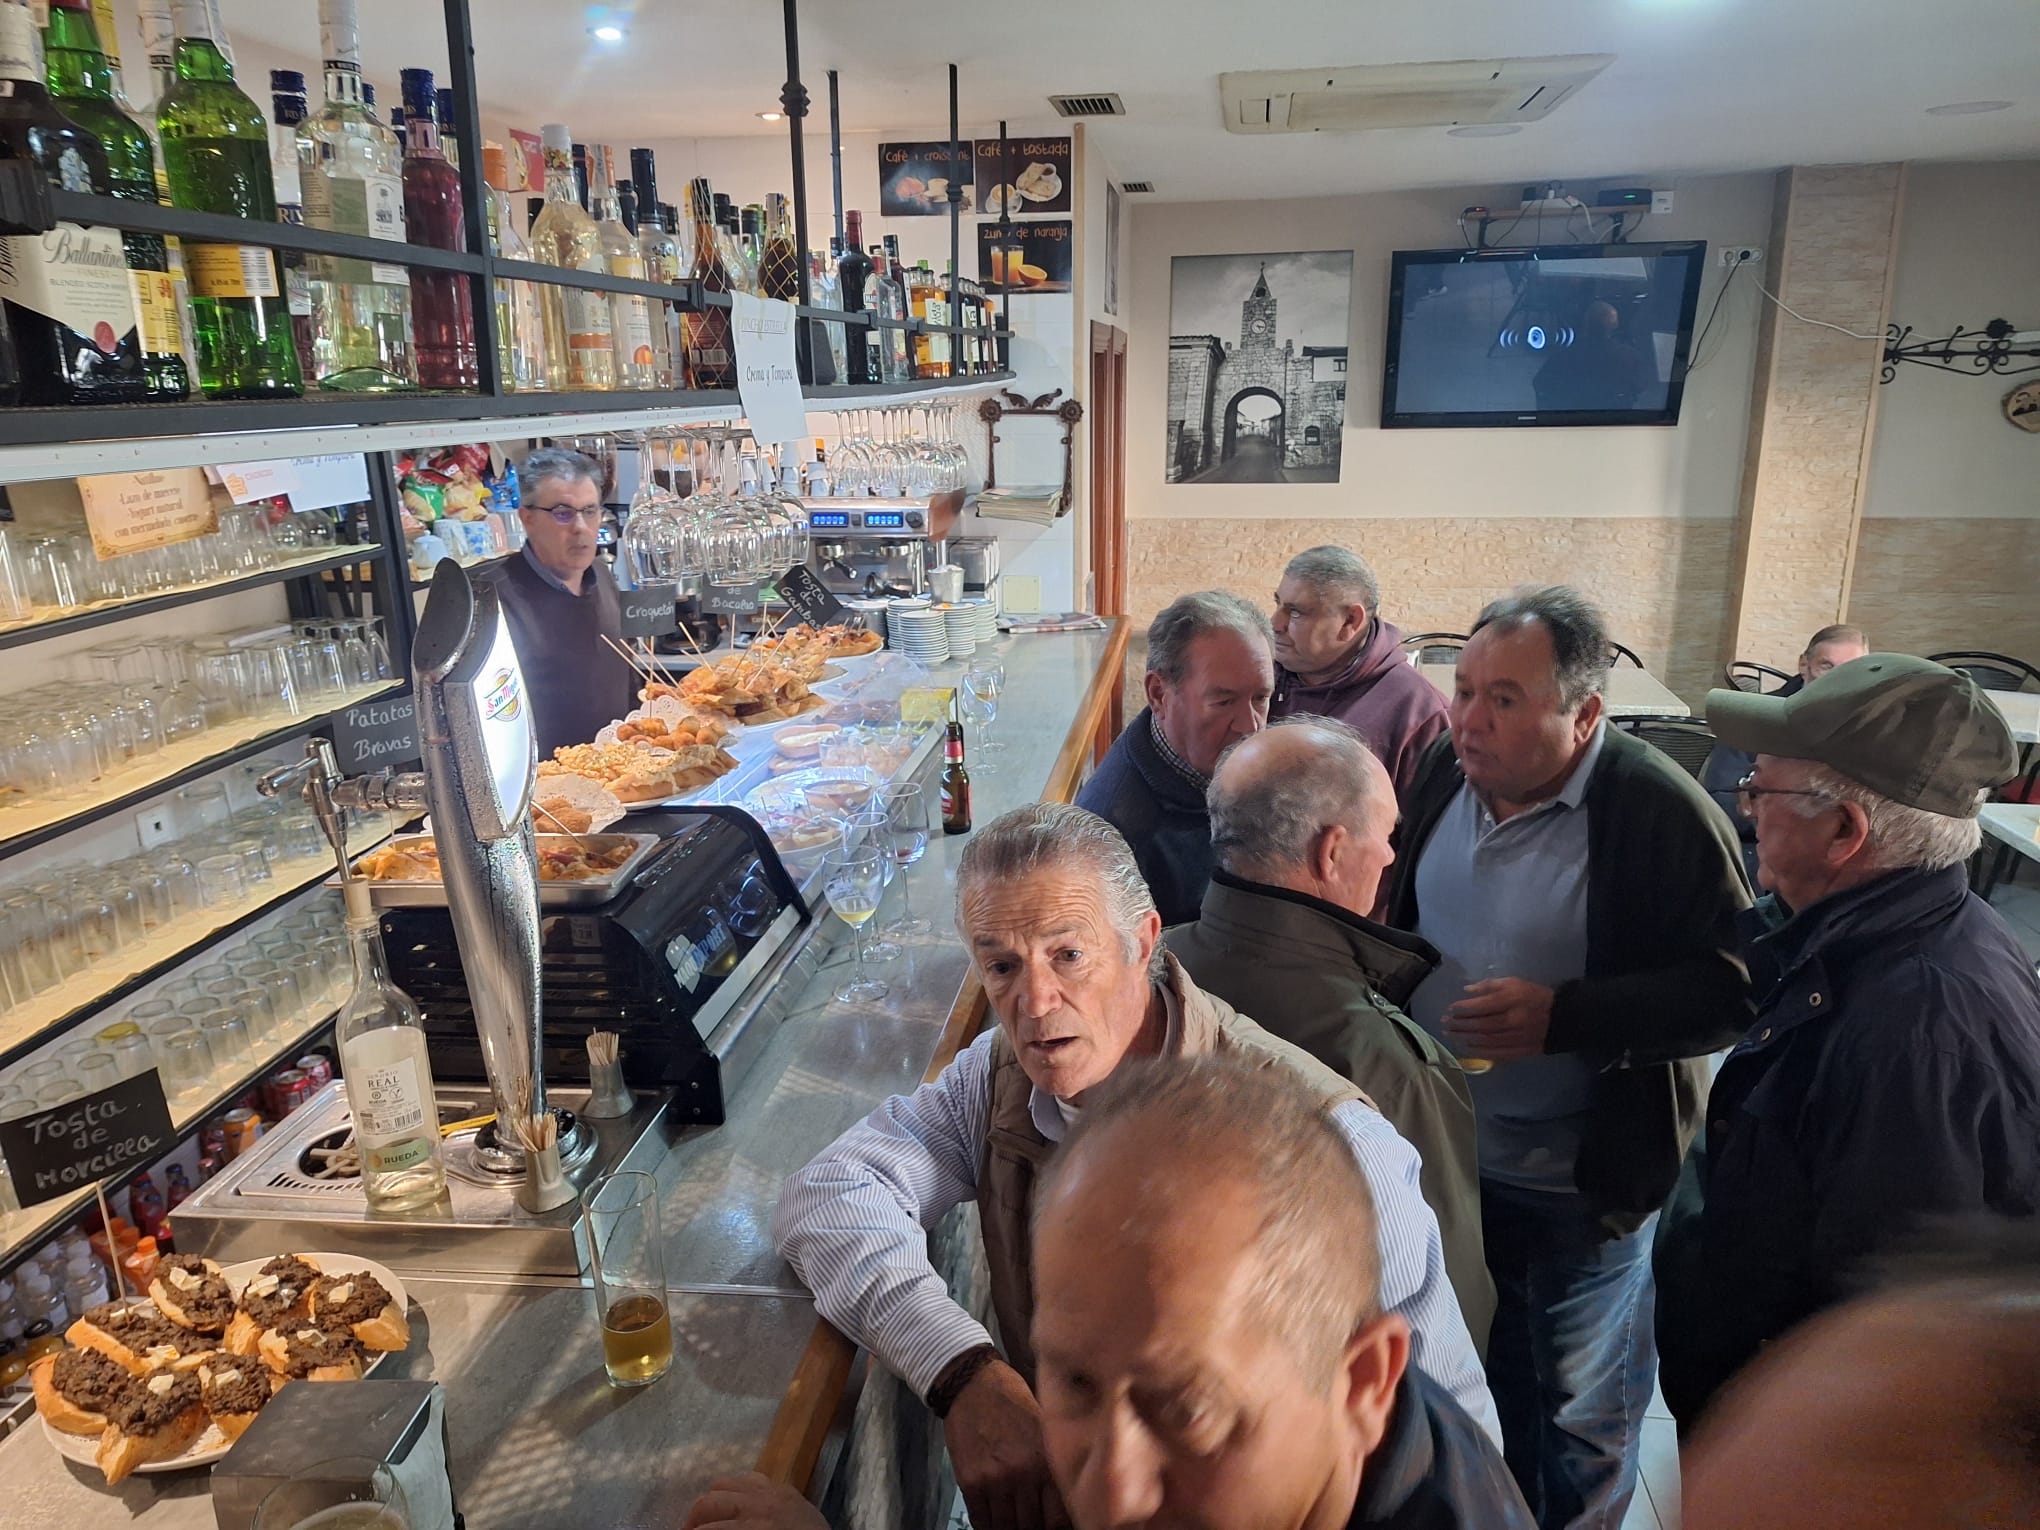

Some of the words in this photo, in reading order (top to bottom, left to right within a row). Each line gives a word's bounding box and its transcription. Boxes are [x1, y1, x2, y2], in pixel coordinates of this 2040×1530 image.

[1023, 142, 1069, 156] tostada
[1016, 227, 1029, 239] de
[1034, 226, 1067, 241] naranja
[799, 589, 813, 607] de
[800, 569, 825, 606] Tosta
[780, 587, 823, 631] Gambas
[346, 703, 413, 728] Patatas
[353, 736, 412, 762] Bravas
[367, 1075, 400, 1088] REAL
[24, 1100, 128, 1145] Tosta
[72, 1127, 111, 1150] de
[34, 1134, 161, 1190] Morcilla
[384, 1150, 419, 1165] RUEDA
